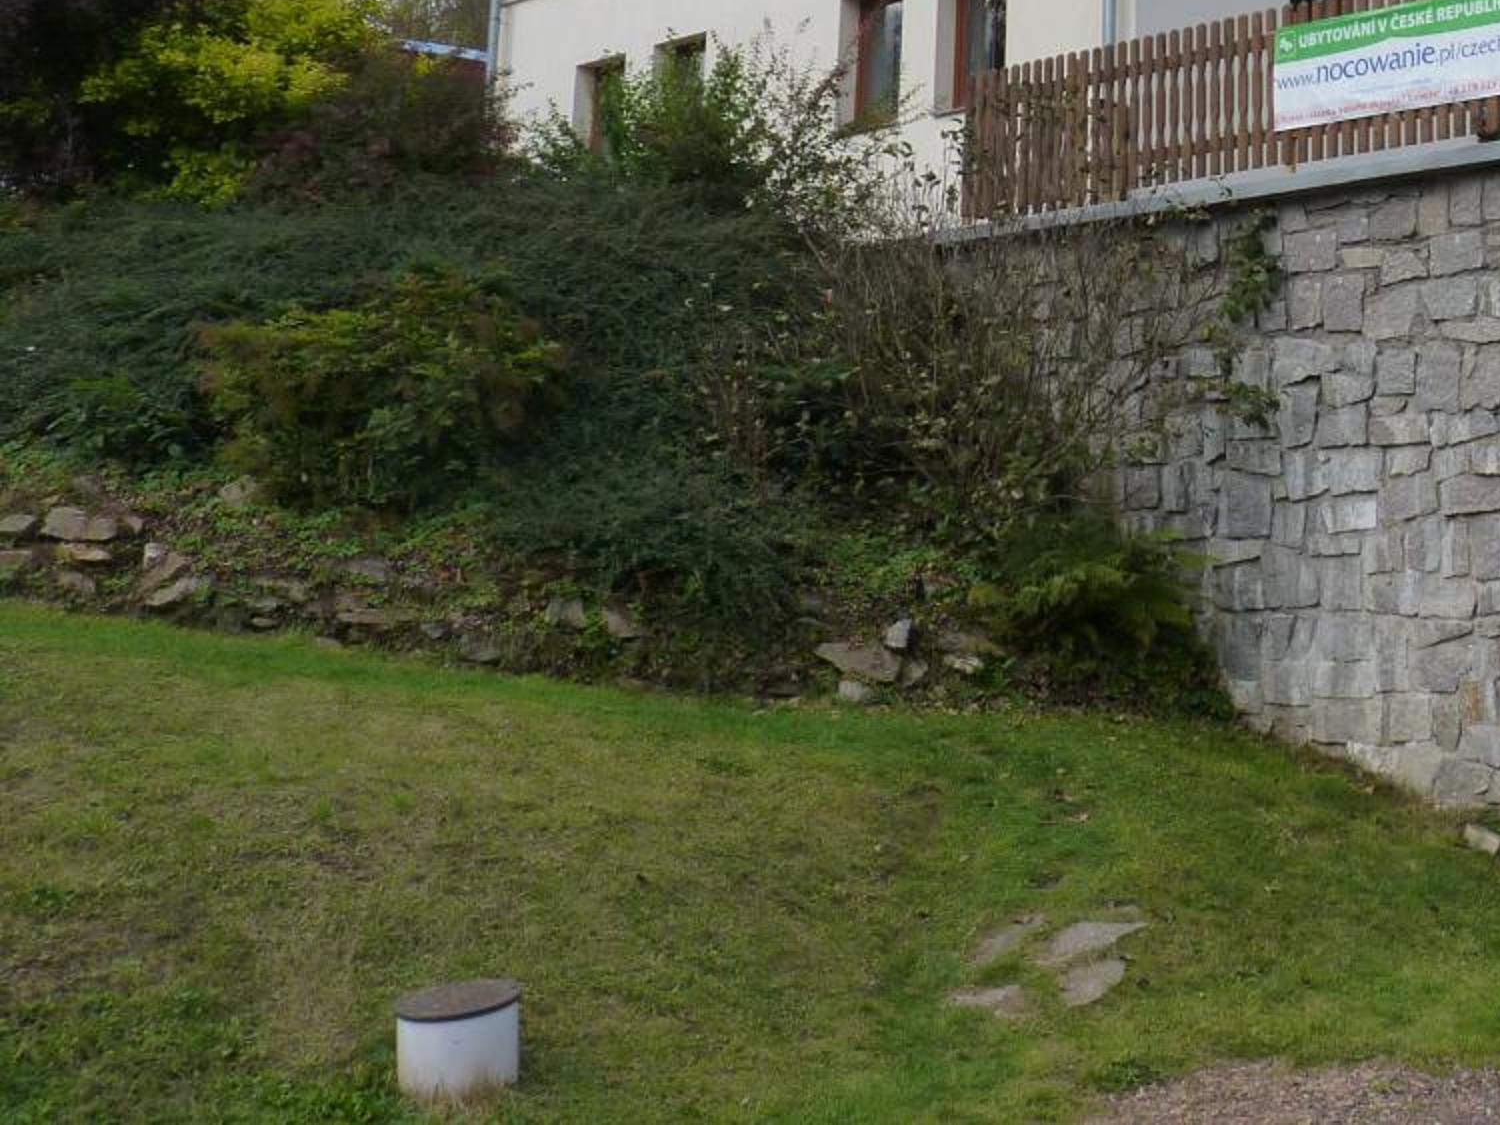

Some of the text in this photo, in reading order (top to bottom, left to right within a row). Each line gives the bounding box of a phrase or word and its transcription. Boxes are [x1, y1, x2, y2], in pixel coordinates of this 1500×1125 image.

[1298, 21, 1376, 48] UBYTOVÁNÍ
[1379, 21, 1388, 32] V
[1391, 8, 1433, 30] ČESKÉ
